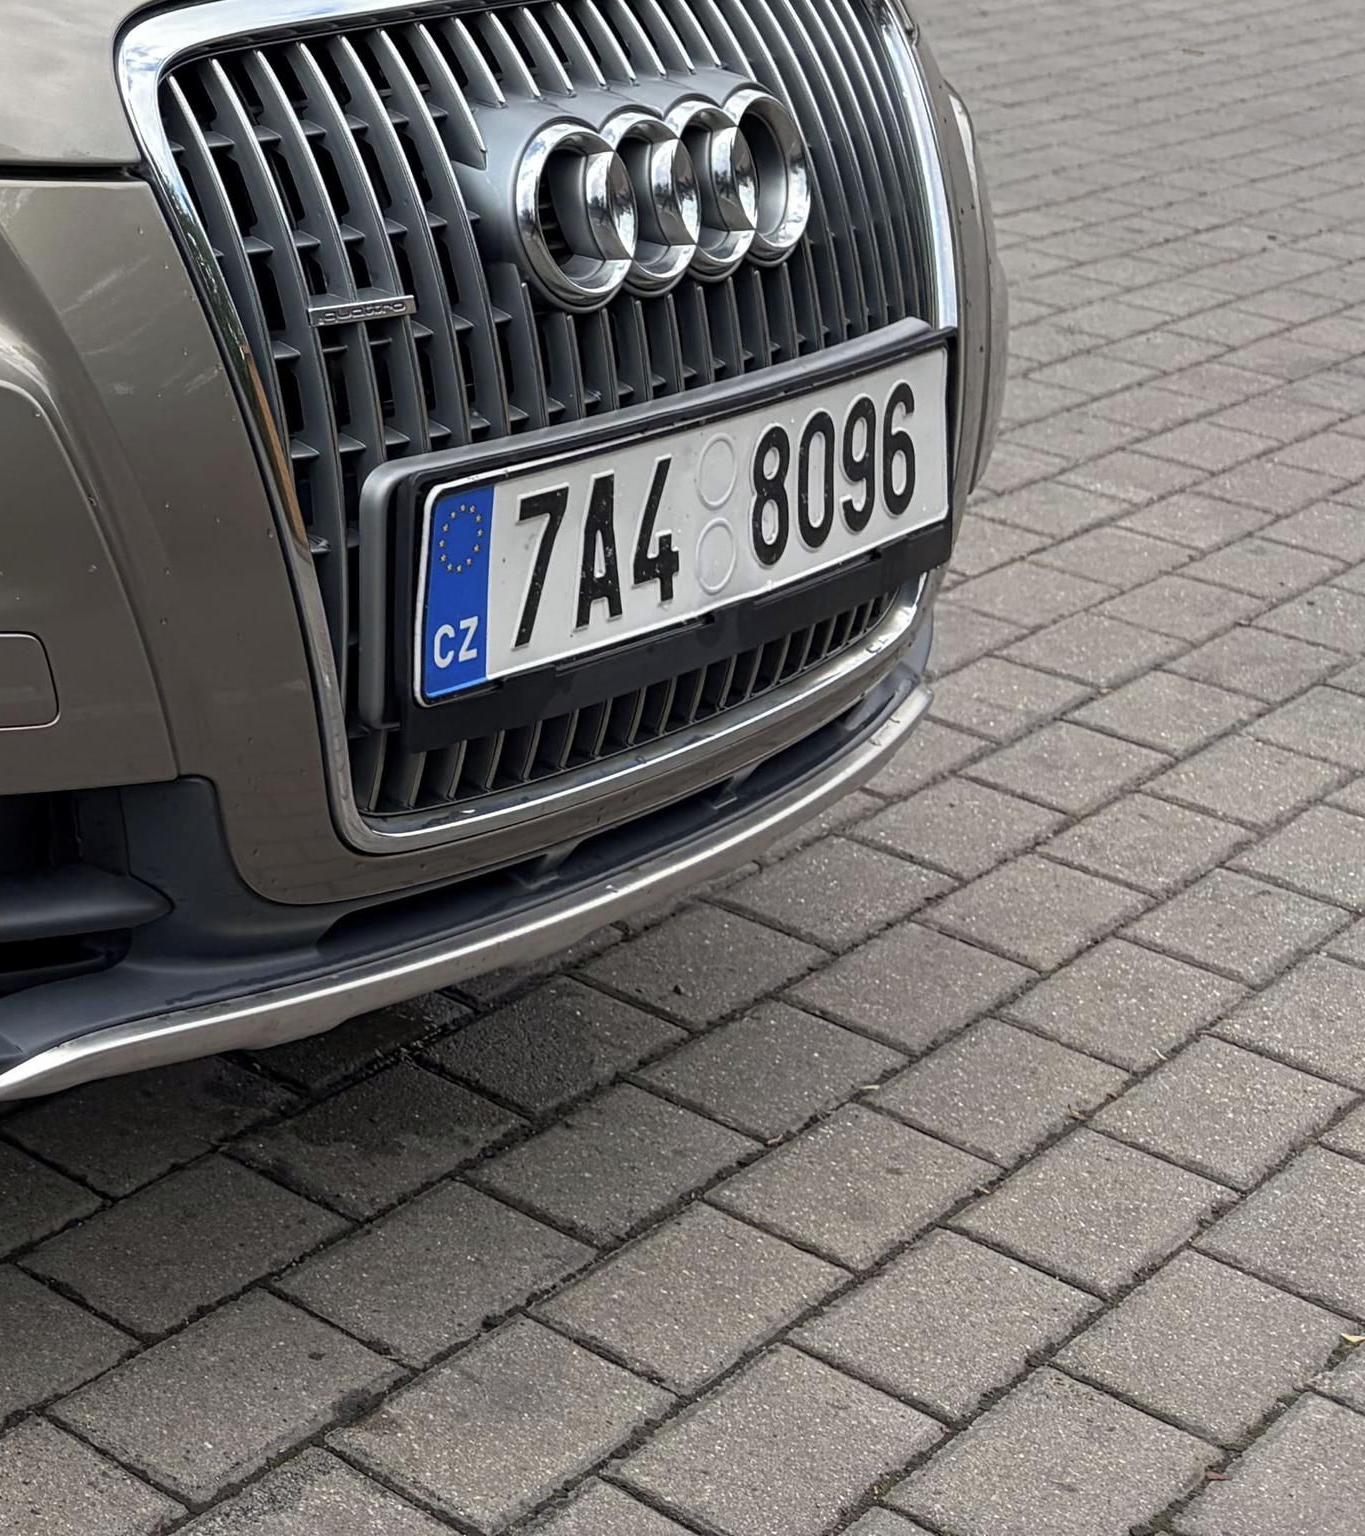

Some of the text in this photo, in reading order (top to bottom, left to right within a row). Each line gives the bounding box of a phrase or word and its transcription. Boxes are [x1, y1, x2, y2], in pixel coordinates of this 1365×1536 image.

[513, 381, 915, 648] 7A4 8096
[433, 616, 479, 668] CZ
